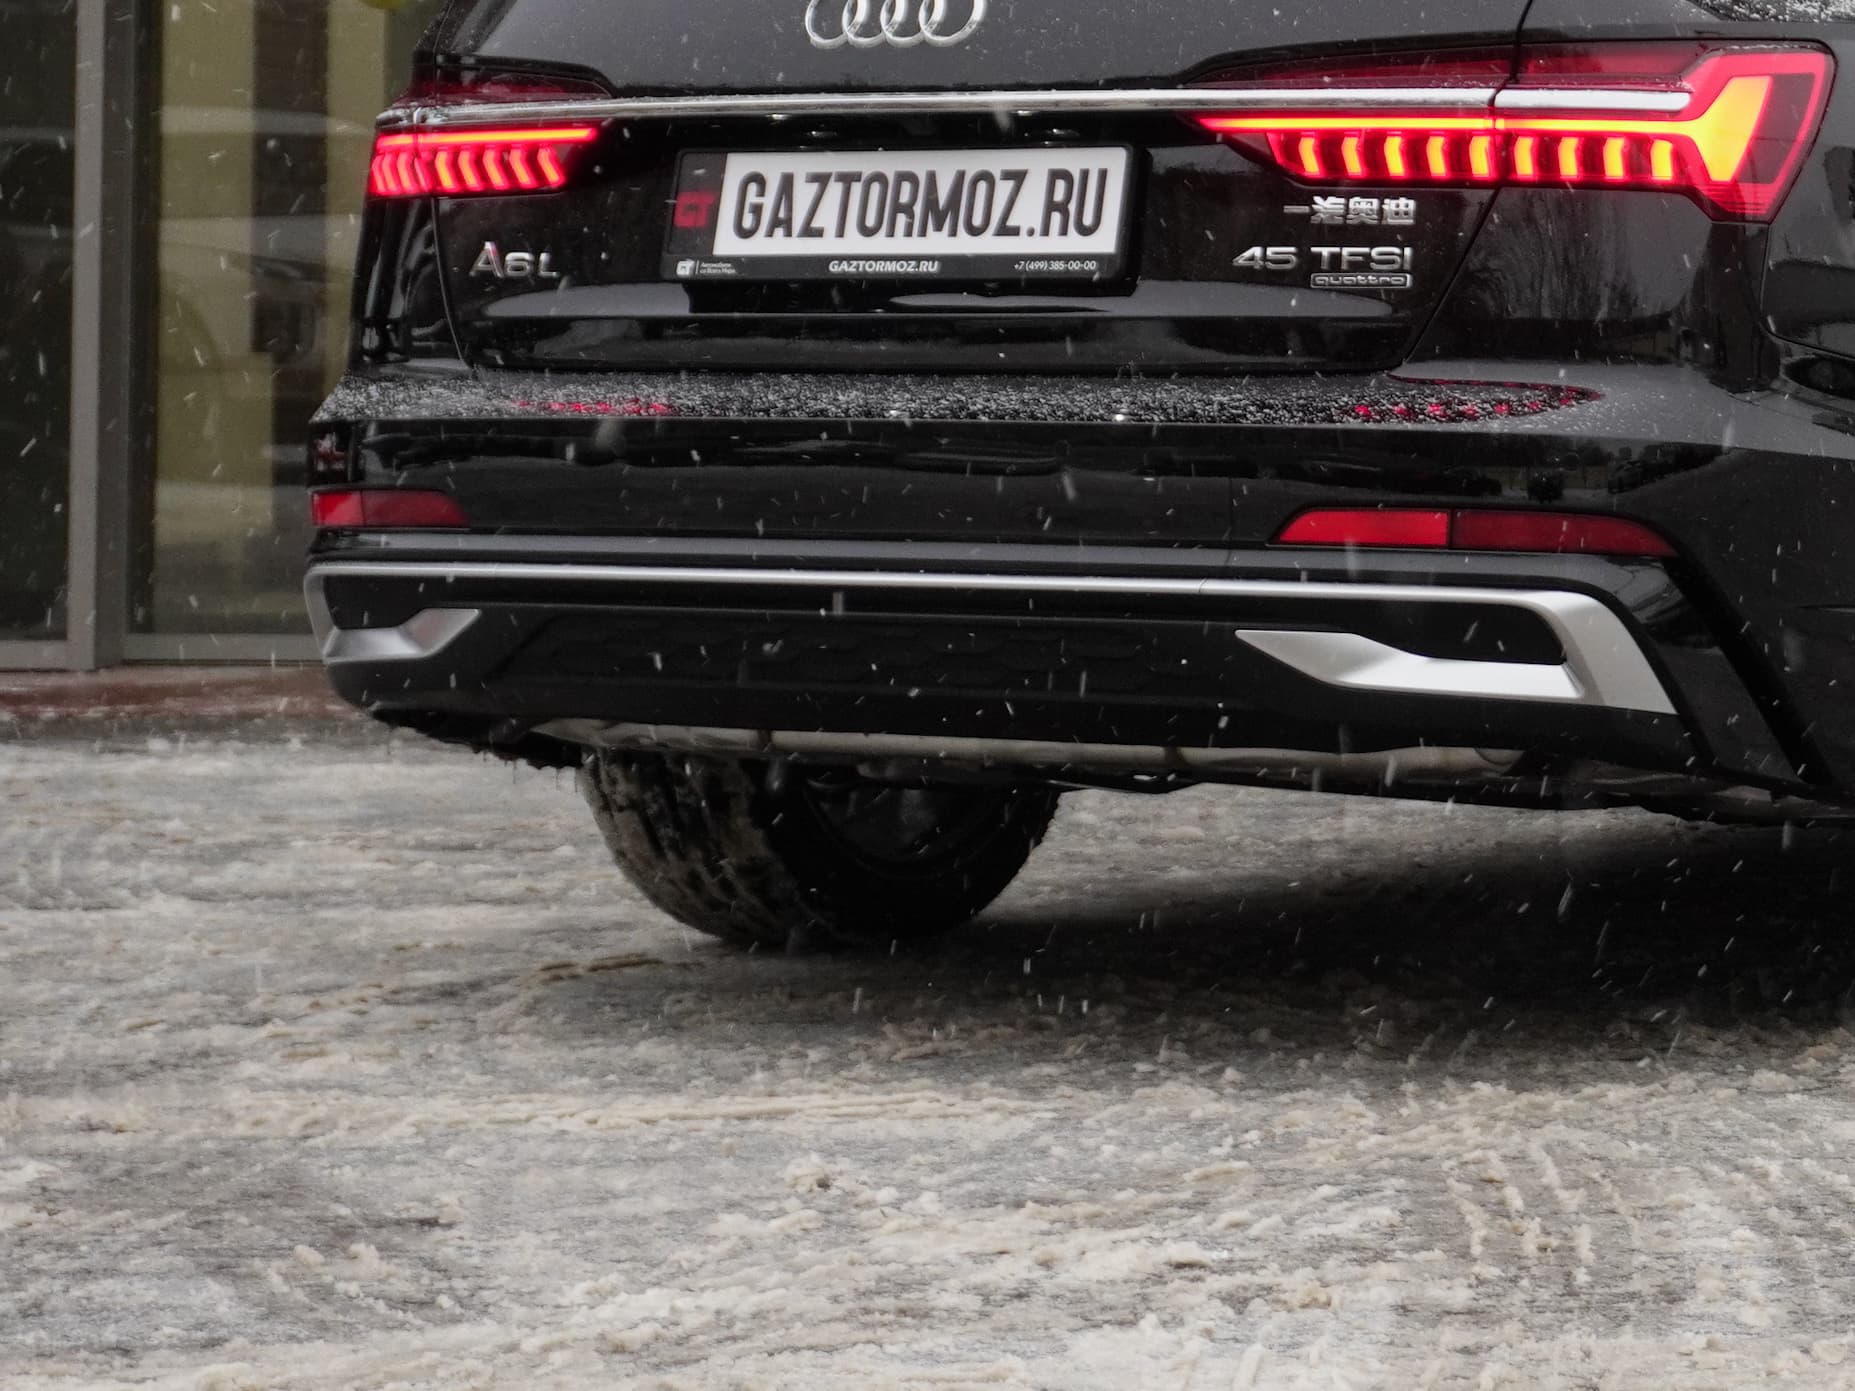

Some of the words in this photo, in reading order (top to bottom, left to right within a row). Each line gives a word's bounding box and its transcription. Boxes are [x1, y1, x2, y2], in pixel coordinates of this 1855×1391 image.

[732, 167, 1108, 240] GAZTORMOZ.RU
[468, 240, 560, 279] A6L
[828, 260, 939, 273] GAZTORMOZ.RU
[1231, 246, 1298, 271] 45
[1310, 246, 1413, 271] TFSI
[1314, 275, 1405, 288] quattro
